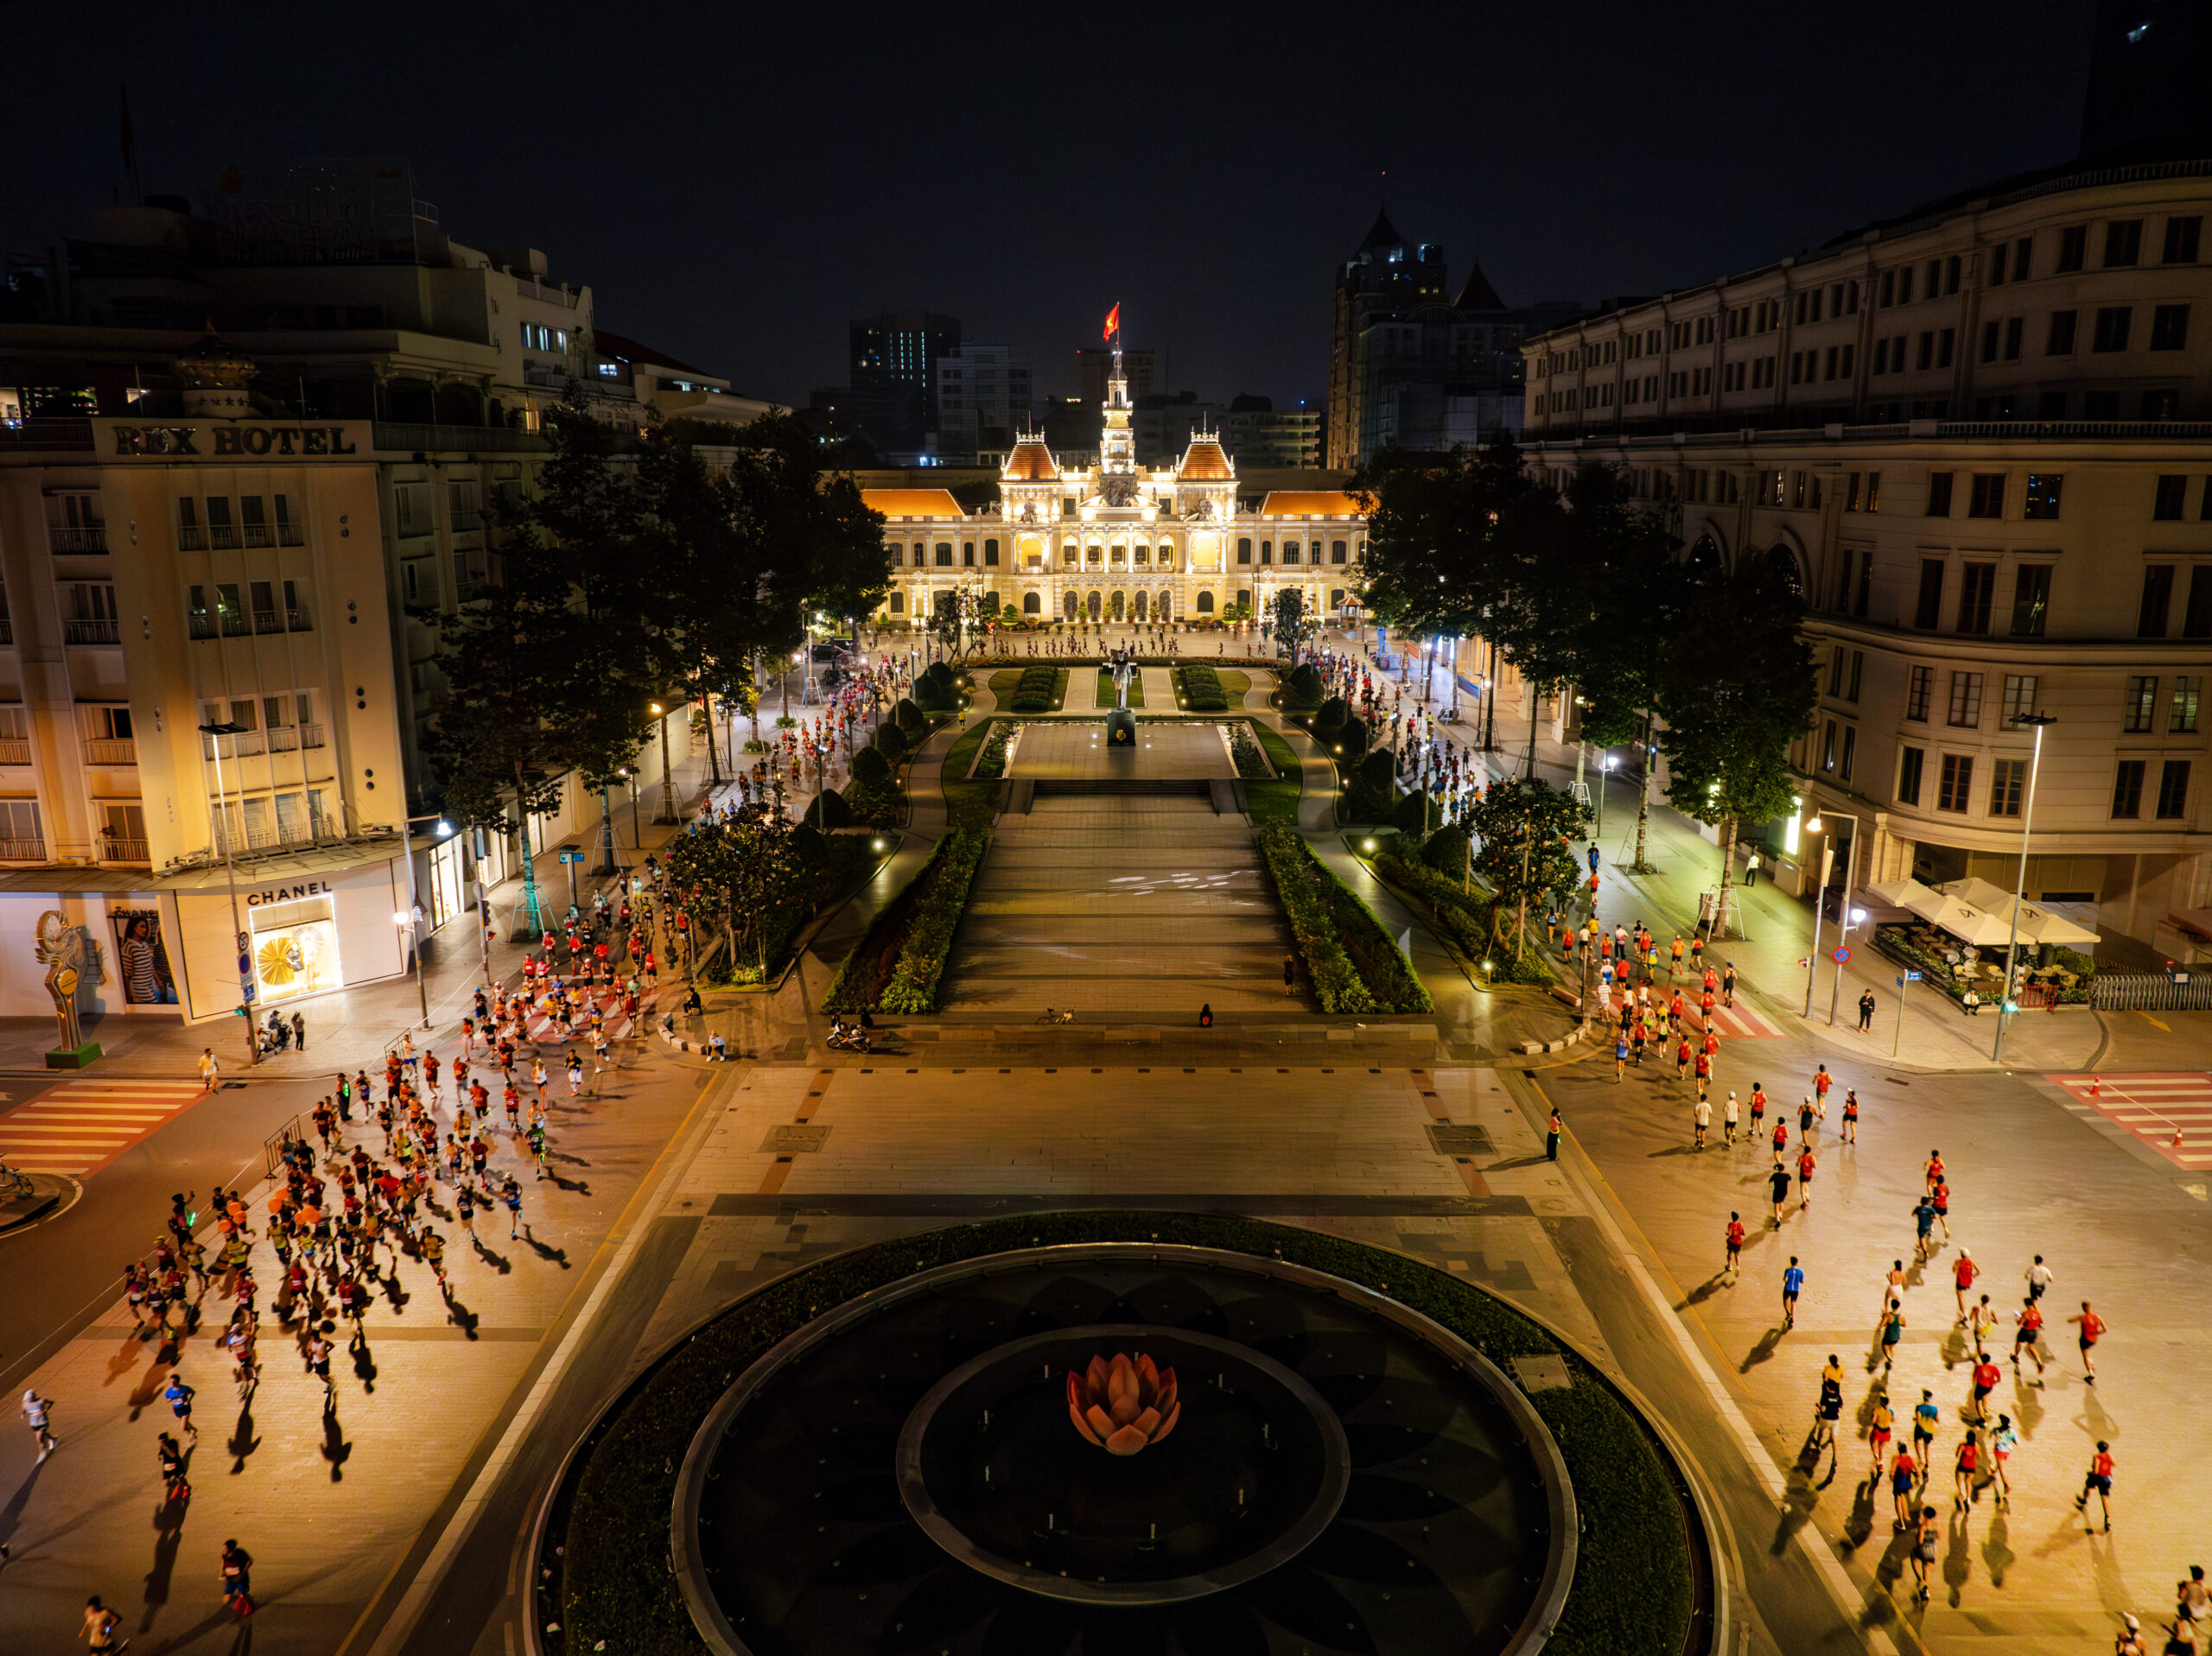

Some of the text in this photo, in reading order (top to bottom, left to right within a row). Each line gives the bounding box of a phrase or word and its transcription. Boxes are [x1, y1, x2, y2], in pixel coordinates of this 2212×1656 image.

[113, 426, 356, 455] REX HOTEL
[247, 881, 332, 905] CHANEL
